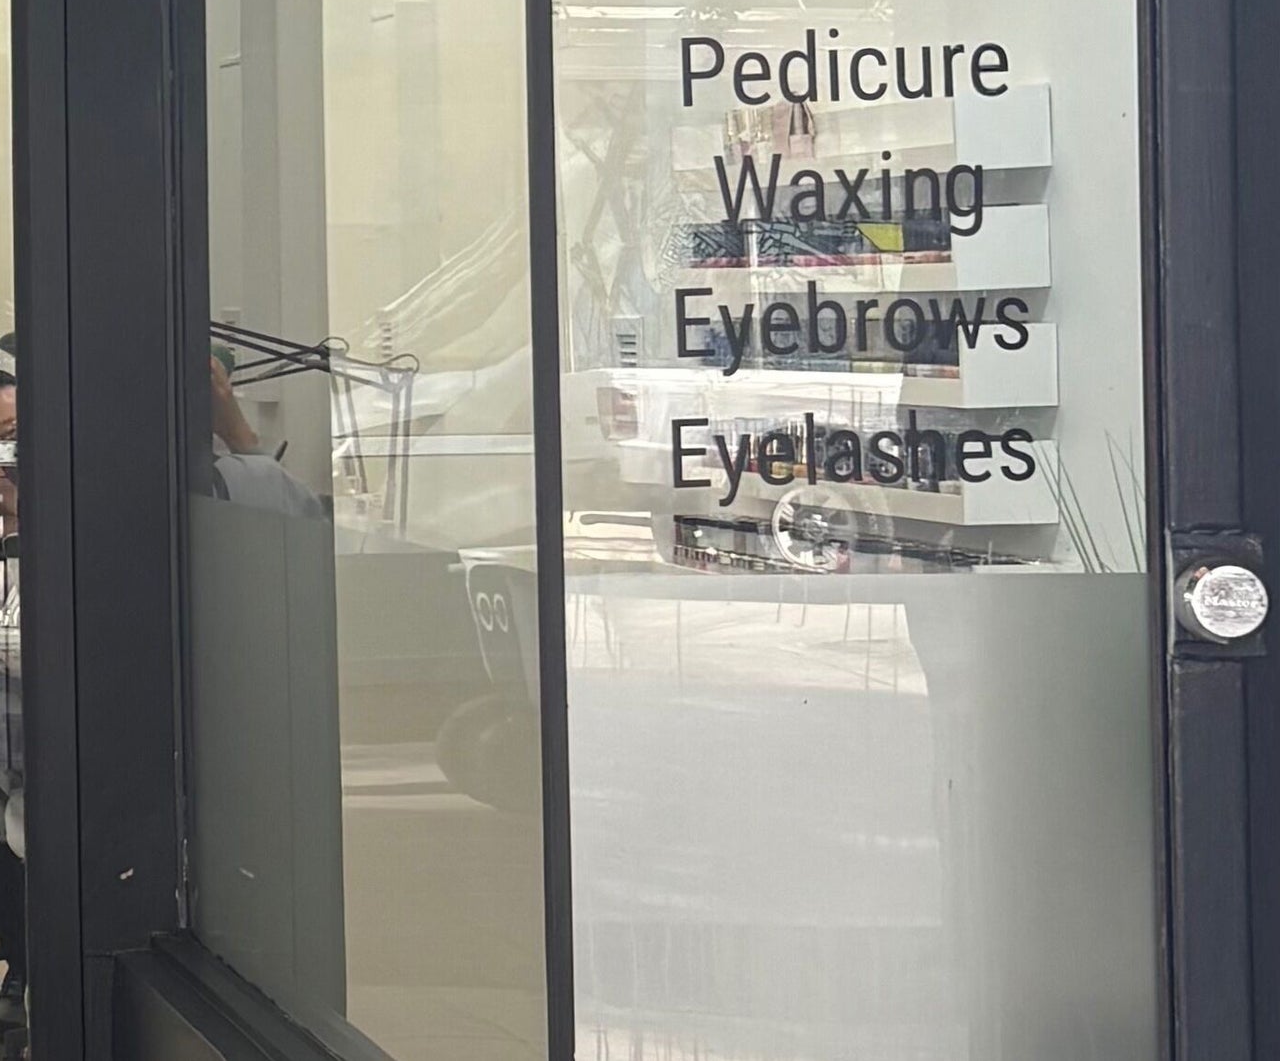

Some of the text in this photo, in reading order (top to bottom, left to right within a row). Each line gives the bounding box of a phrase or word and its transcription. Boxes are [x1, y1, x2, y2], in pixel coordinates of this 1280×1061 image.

[682, 29, 1008, 108] Pedicure
[713, 151, 986, 238] Waxing
[677, 281, 1028, 376] Eyebrows
[673, 411, 1035, 506] Eyelashes
